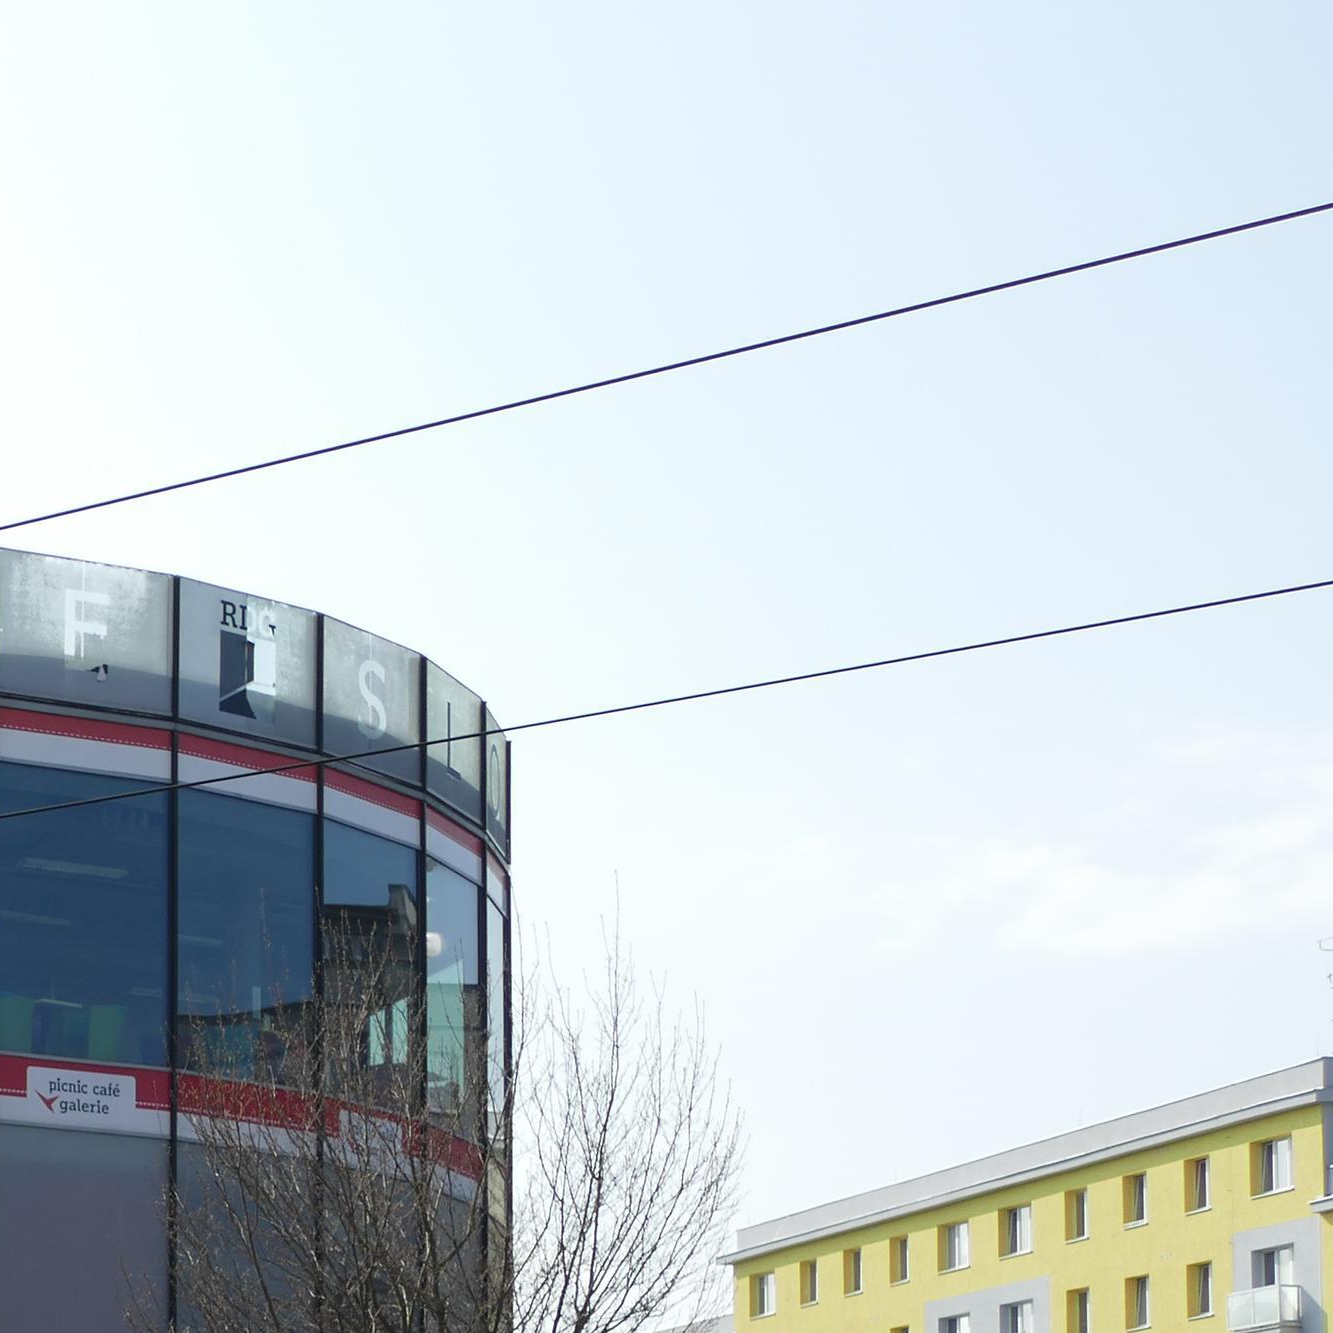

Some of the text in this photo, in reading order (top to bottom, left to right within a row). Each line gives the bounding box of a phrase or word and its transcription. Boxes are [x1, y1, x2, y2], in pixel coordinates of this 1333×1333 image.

[48, 1077, 120, 1097] picnic café
[59, 1099, 109, 1115] galerie
